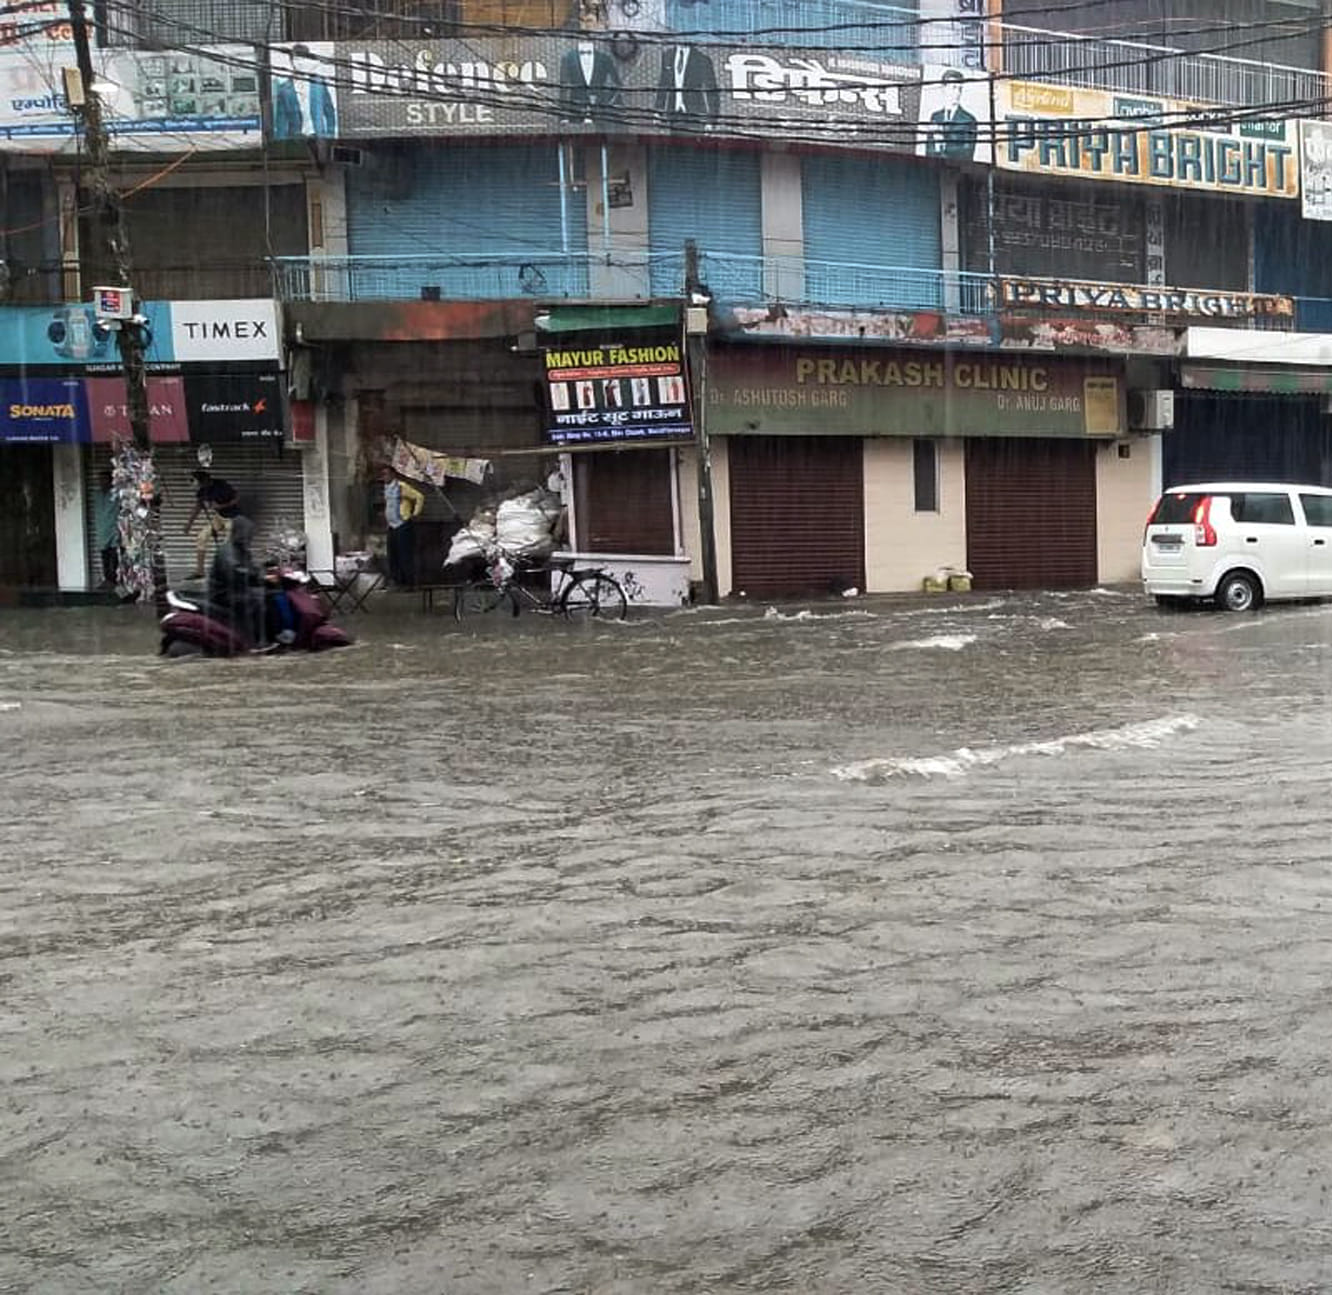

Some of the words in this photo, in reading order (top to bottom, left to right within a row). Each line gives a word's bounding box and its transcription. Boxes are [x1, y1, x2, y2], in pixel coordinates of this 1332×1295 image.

[406, 102, 495, 124] STYLE
[1004, 113, 1140, 176] PRIYA
[1148, 128, 1292, 191] BRIGHT
[1012, 283, 1133, 310] PRIYA
[183, 321, 268, 339] TIMEX
[546, 349, 604, 368] MAYUR
[609, 346, 680, 364] FASHION
[796, 357, 944, 388] PRAKASH
[953, 365, 1050, 392] CLINIC
[733, 388, 807, 407] ASHUTOSH
[810, 390, 848, 408] GARG
[1016, 394, 1046, 411] ANUJ
[1049, 396, 1081, 413] GARG
[10, 404, 76, 418] SONATA
[116, 405, 173, 417] TAN
